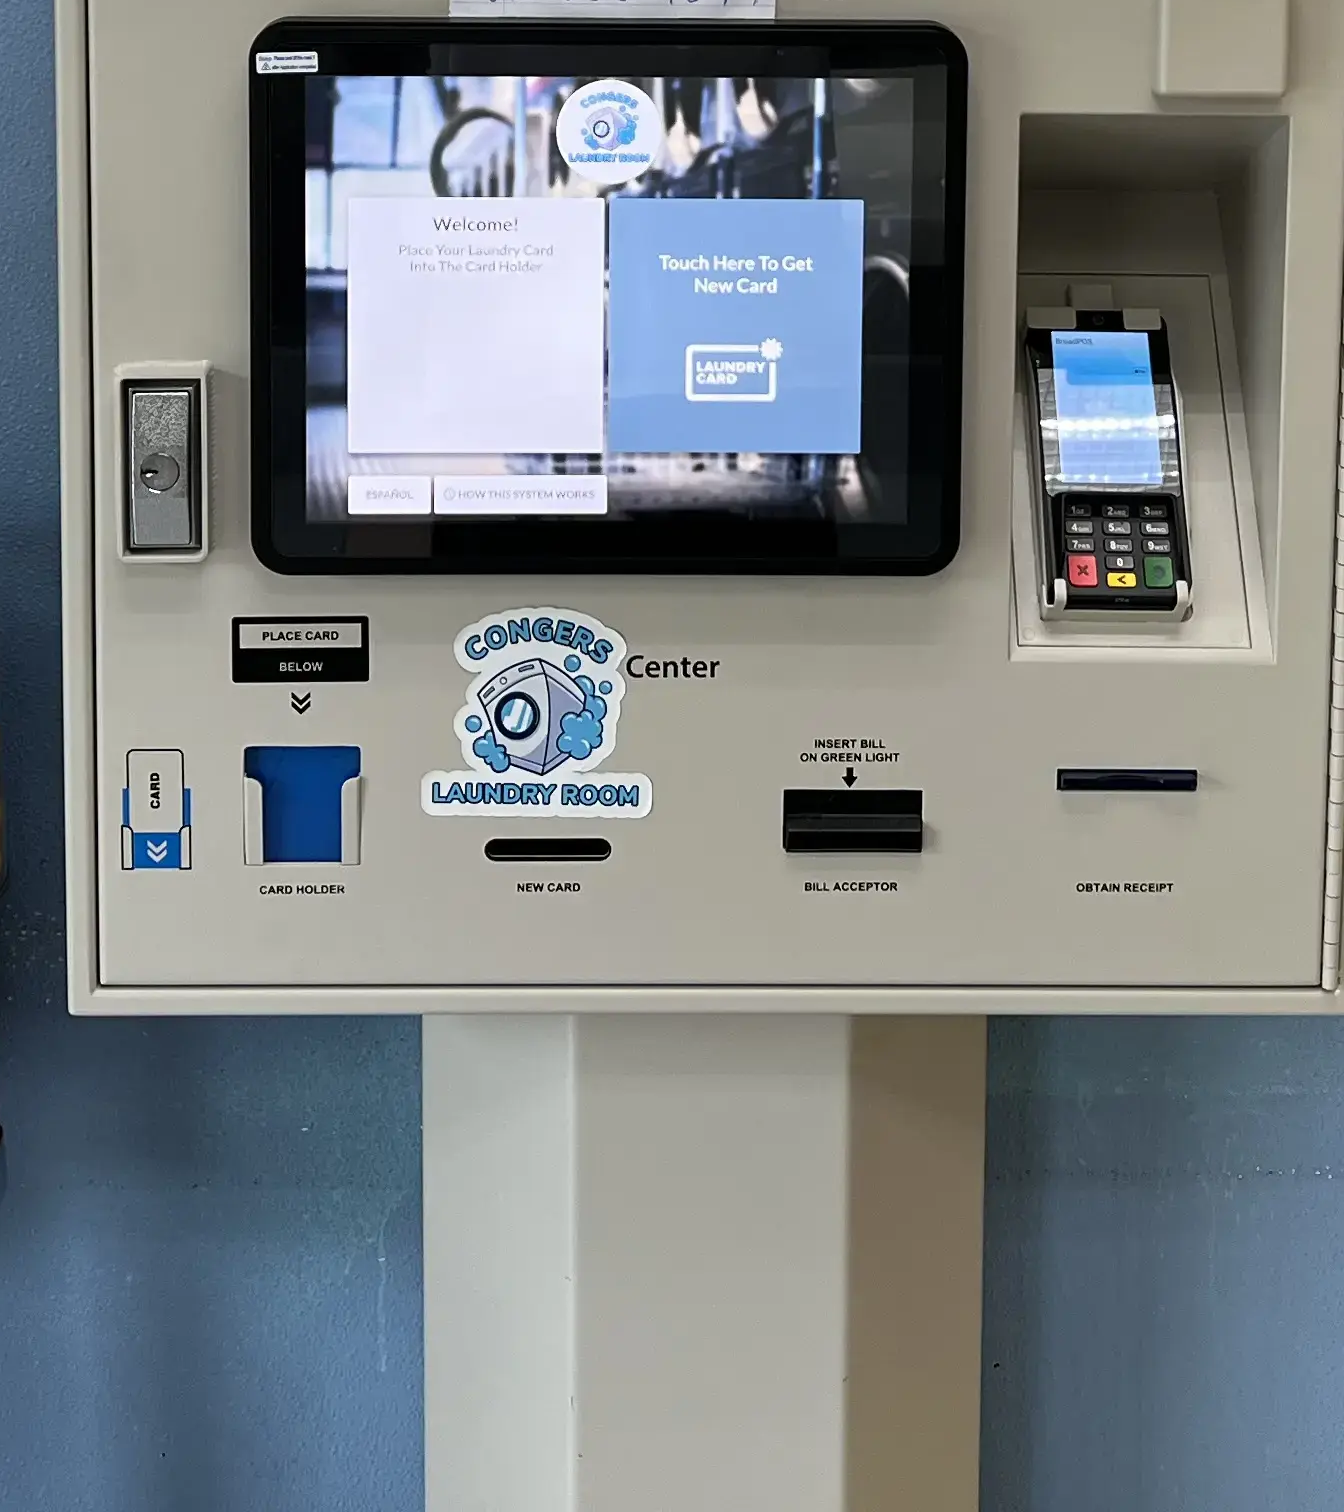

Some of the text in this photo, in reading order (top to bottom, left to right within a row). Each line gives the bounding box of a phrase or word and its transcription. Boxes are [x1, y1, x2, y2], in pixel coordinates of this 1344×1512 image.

[432, 216, 520, 233] Welcome!
[398, 244, 554, 259] Place Your Laundry Card
[409, 261, 543, 273] Into The Card Holder
[659, 254, 814, 273] Touch Here To Get
[693, 278, 778, 295] New Card
[696, 361, 765, 373] LAUNDRY
[696, 372, 737, 385] CARD
[365, 488, 414, 500] ESPAÑOL
[457, 490, 596, 500] HOW THIS SYSTEM WORKS
[261, 630, 340, 642] PLACE CARD
[463, 616, 615, 665] CONGERS
[278, 661, 324, 673] BELOW
[624, 653, 721, 681] Center
[813, 738, 886, 749] INSERT BILL
[799, 752, 900, 763] ON GREEN LIGHT
[149, 771, 161, 810] CARD
[431, 781, 640, 808] LAUNDRY ROOM
[259, 884, 346, 895] CARD HOLDER
[516, 882, 582, 893] NEW CARD
[803, 881, 899, 893] BILL ACCEPTOR
[1075, 882, 1175, 894] OBTAIN RECEIPT
